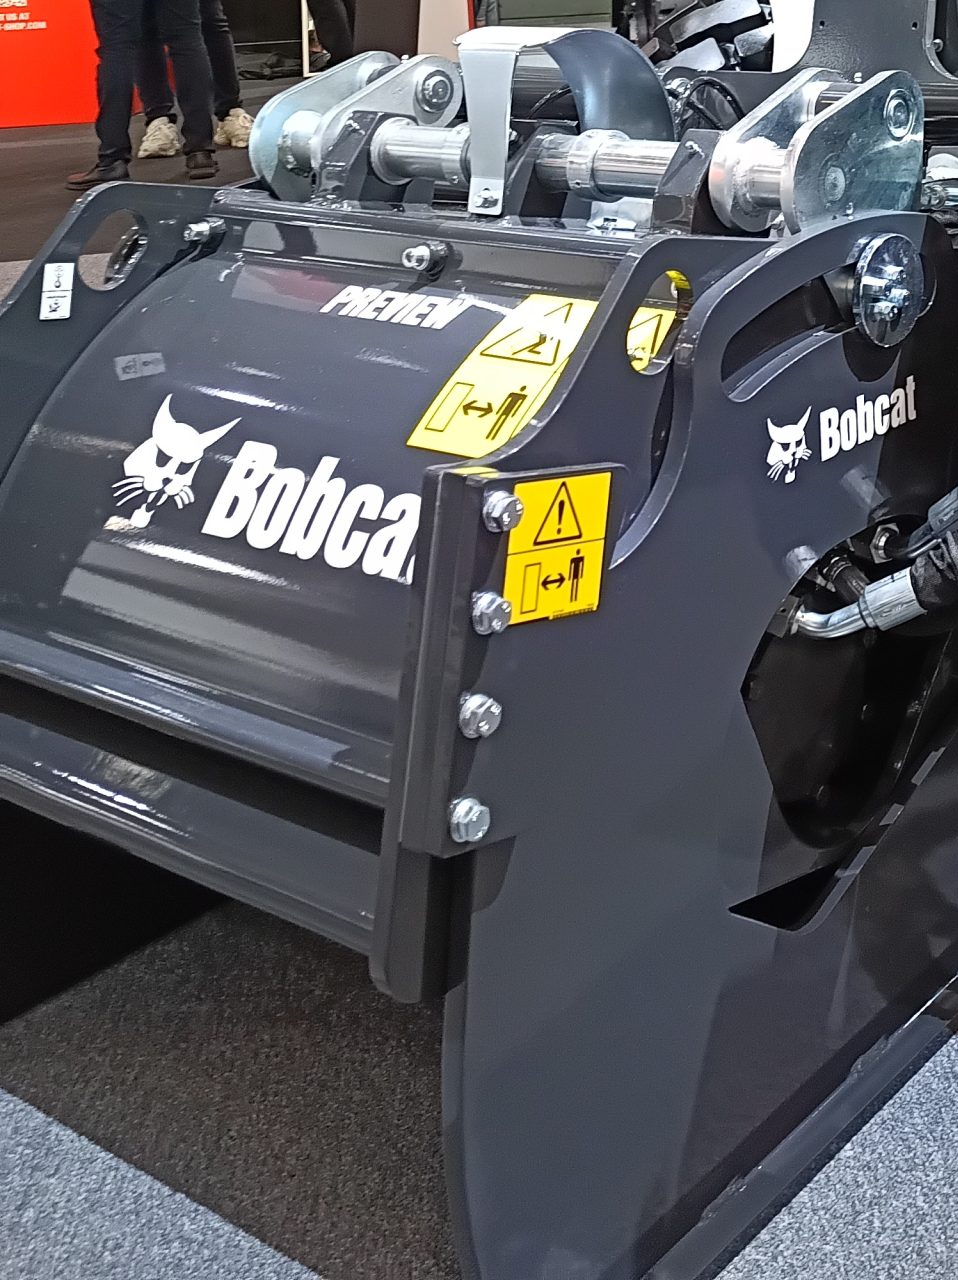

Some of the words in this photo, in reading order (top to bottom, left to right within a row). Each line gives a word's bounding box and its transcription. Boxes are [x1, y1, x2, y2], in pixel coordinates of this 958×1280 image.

[319, 285, 466, 330] PREVIEW
[819, 374, 917, 462] Bobcat
[200, 440, 423, 585] Bobca
